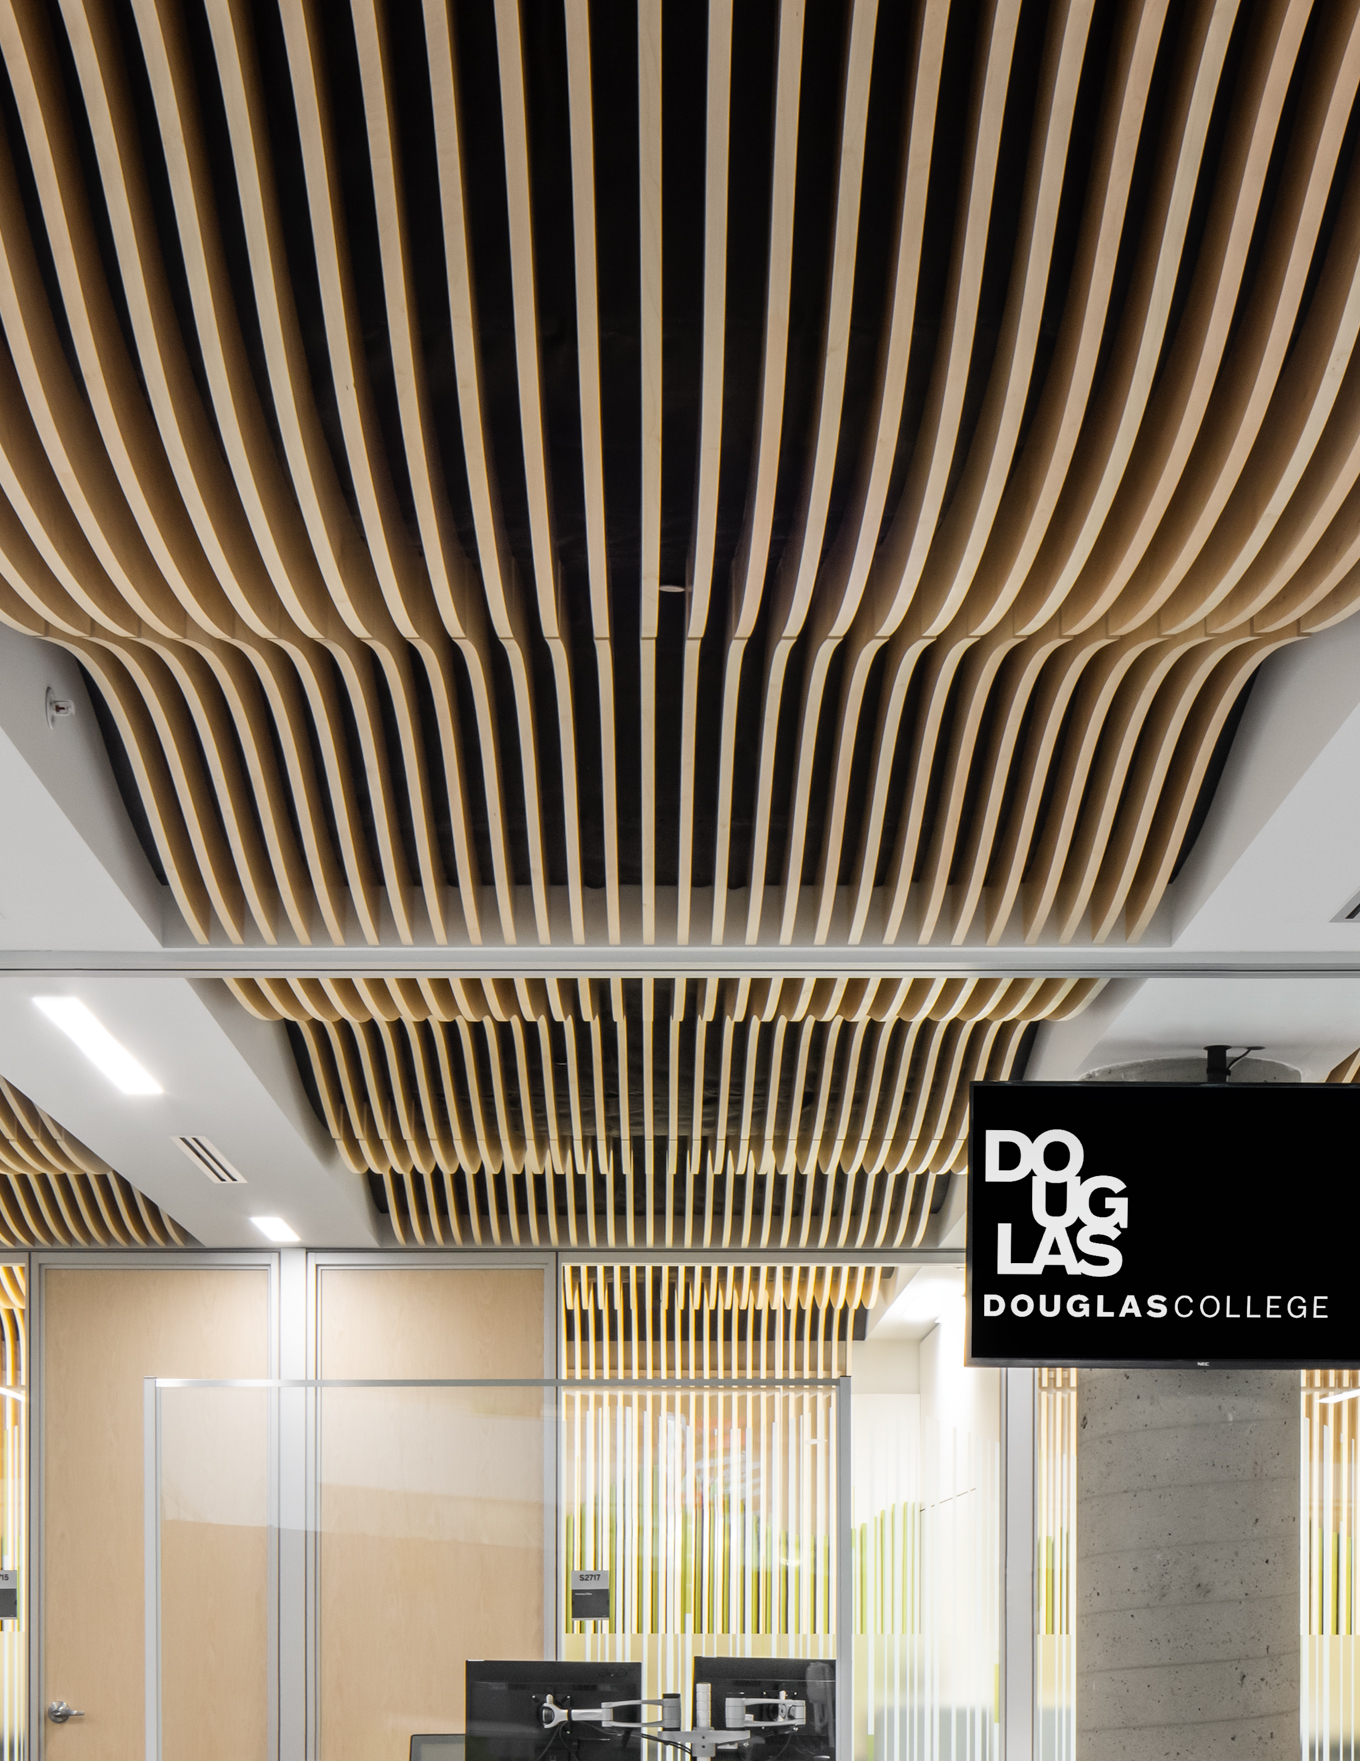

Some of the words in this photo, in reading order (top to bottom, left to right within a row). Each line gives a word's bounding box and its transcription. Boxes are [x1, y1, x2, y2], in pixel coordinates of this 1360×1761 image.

[985, 1129, 1084, 1183] DO
[1032, 1175, 1128, 1229] UG
[997, 1223, 1123, 1277] LAS
[579, 1574, 601, 1582] S2717
